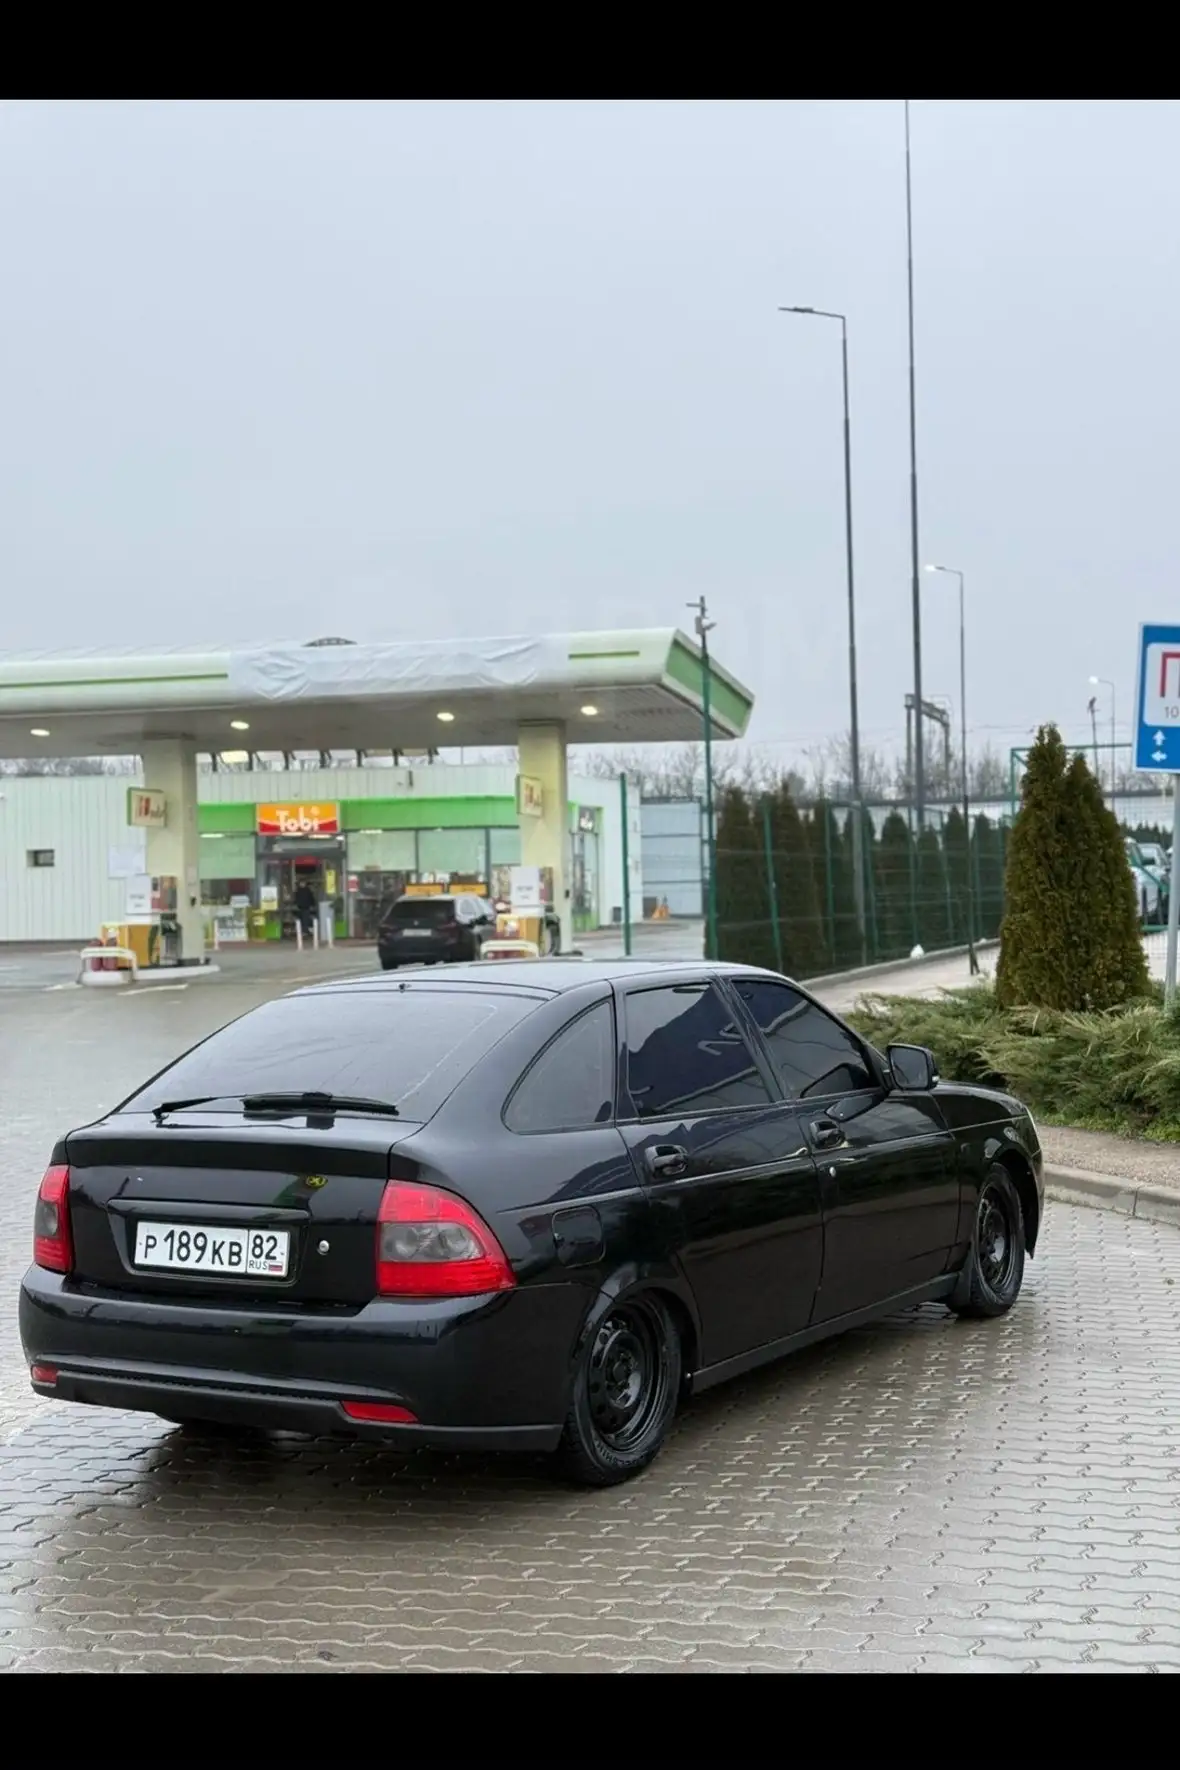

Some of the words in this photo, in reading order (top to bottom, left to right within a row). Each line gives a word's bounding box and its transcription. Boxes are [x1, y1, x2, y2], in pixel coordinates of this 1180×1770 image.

[276, 806, 320, 832] Tobi
[251, 1234, 278, 1260] 82
[249, 1260, 268, 1270] RUS
